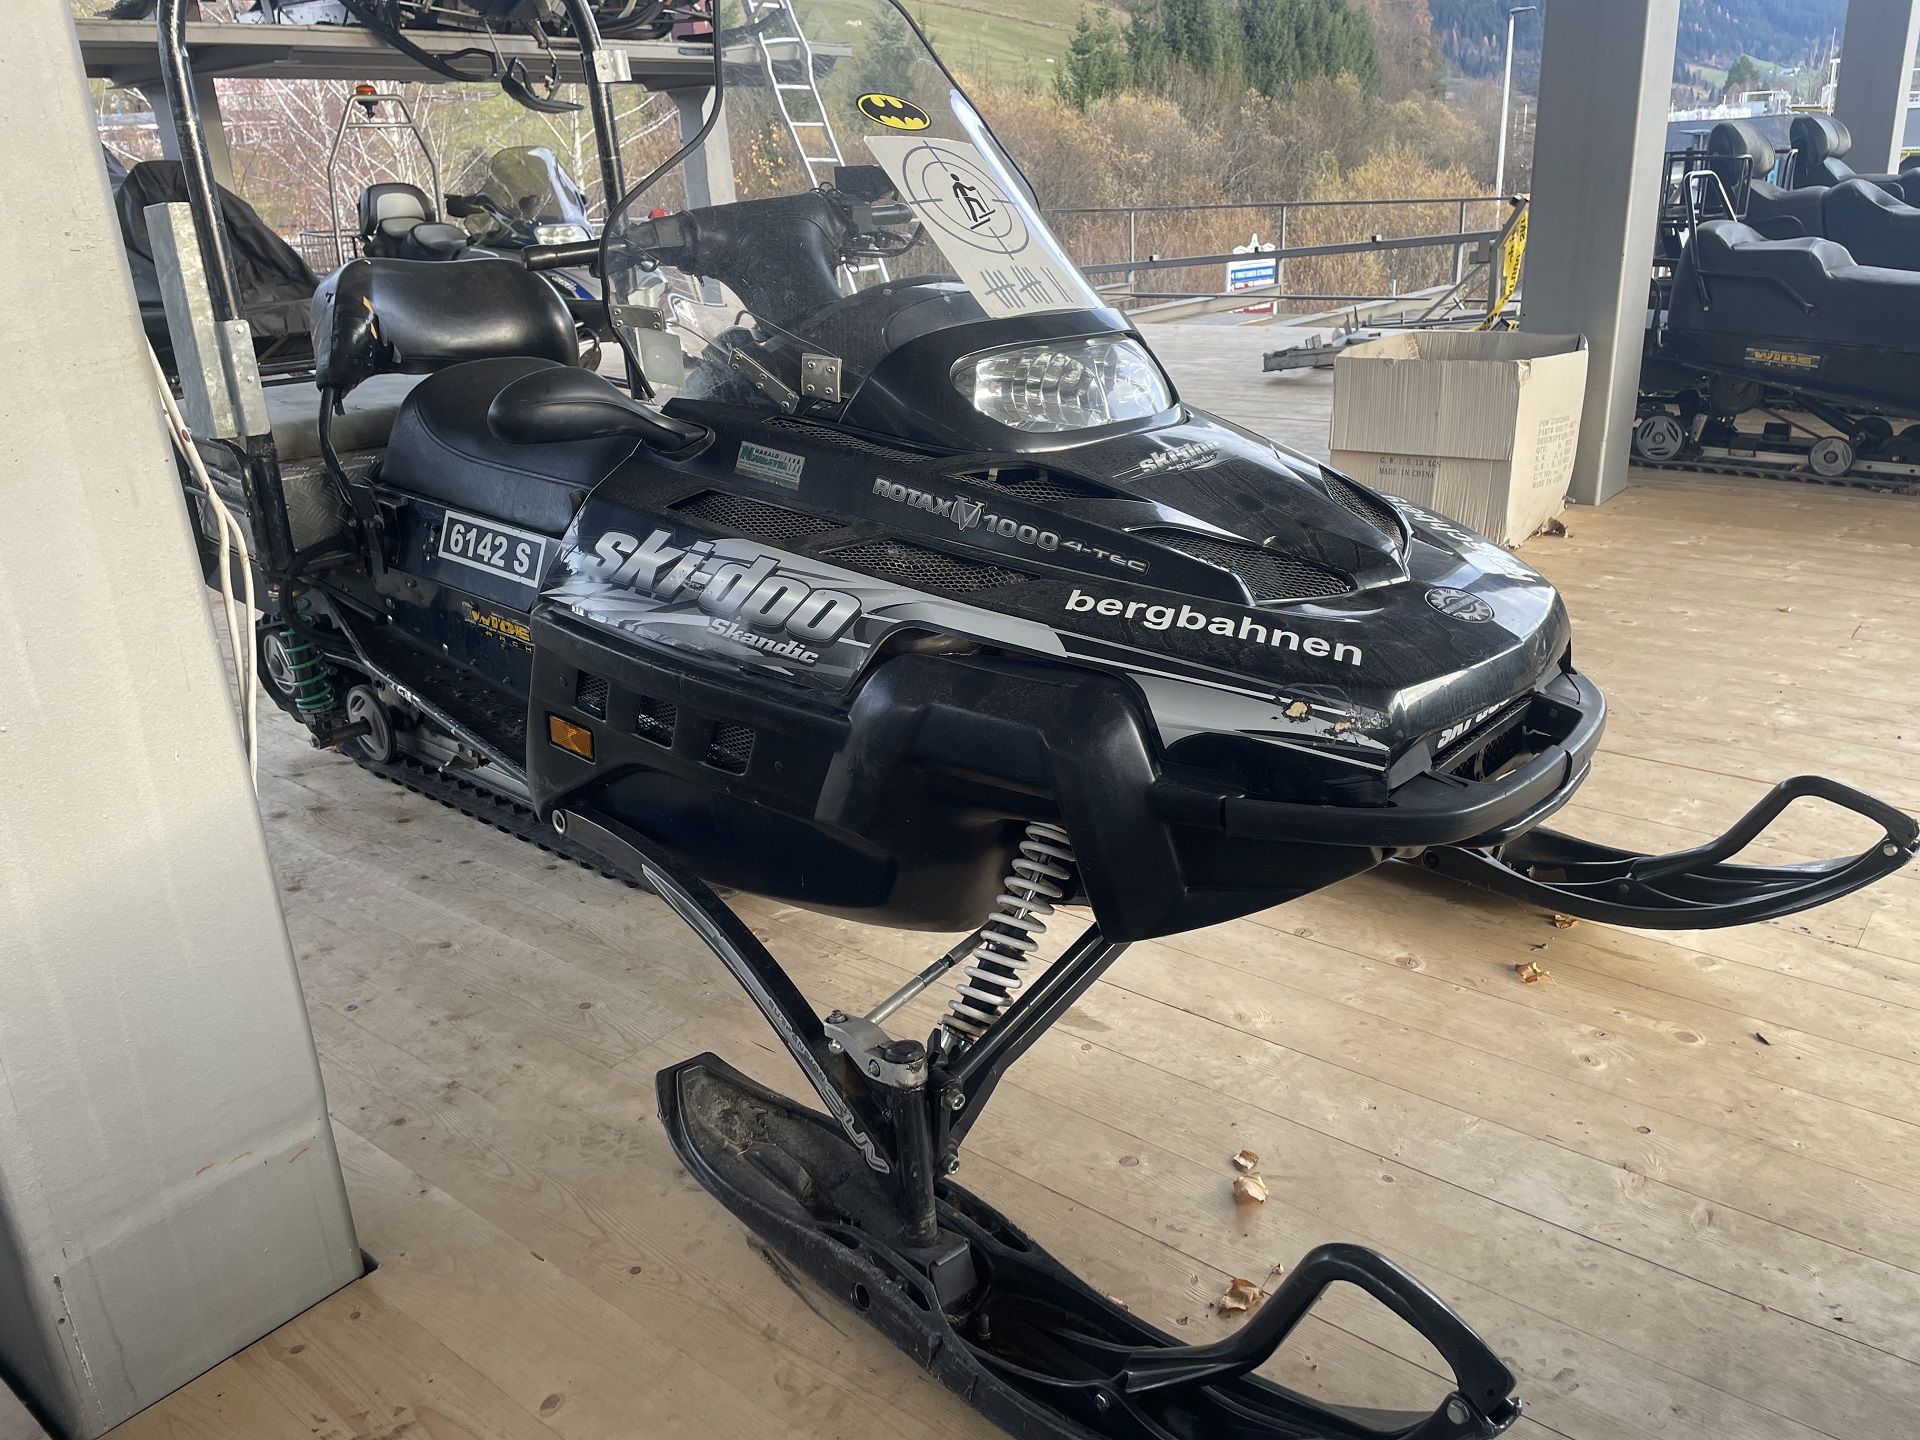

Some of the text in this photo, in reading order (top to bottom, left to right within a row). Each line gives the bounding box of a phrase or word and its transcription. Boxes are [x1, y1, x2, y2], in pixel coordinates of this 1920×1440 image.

[754, 448, 780, 459] HARALD
[1379, 467, 1397, 476] MADE
[1412, 470, 1435, 478] CHINA
[1428, 459, 1442, 468] KGS
[872, 476, 951, 518] ROTAX
[983, 513, 1062, 552] 1000
[450, 523, 531, 574] 6142 S
[579, 529, 862, 645] ski-doo
[706, 616, 819, 667] Skandic
[1064, 589, 1364, 666] bergbahnen
[767, 998, 827, 1082] SUSPENSION
[823, 1083, 890, 1174] SUV
